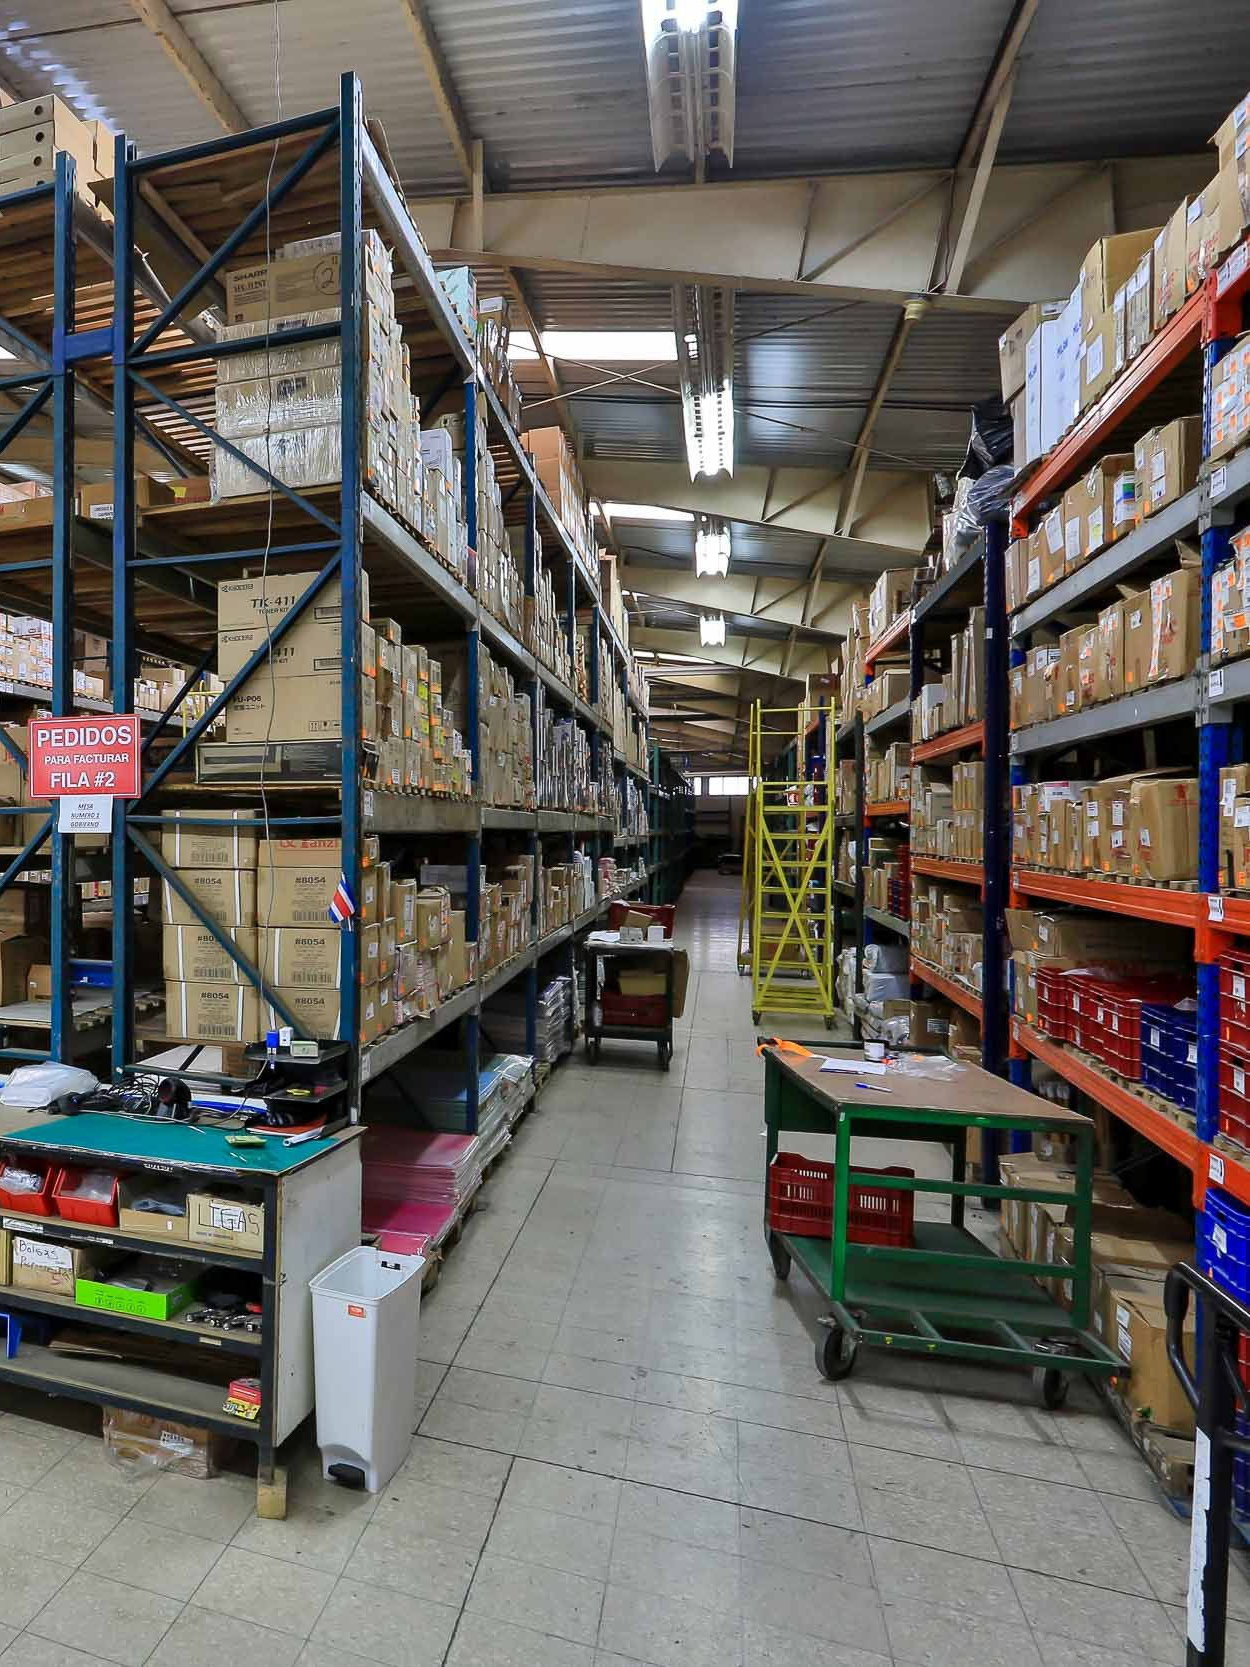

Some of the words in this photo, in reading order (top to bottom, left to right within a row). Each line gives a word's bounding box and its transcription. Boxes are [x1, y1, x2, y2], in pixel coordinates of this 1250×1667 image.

[250, 596, 295, 608] TK-411
[37, 725, 132, 748] PEDIDOS
[44, 755, 71, 765] PARA
[73, 753, 130, 764] FACTURAR
[51, 772, 91, 788] FILA
[94, 771, 116, 787] #2
[194, 877, 223, 885] #8054
[295, 876, 327, 884] #8054
[295, 938, 325, 946] #8054
[201, 992, 230, 1000] #8054
[198, 1200, 260, 1236] LIGAS
